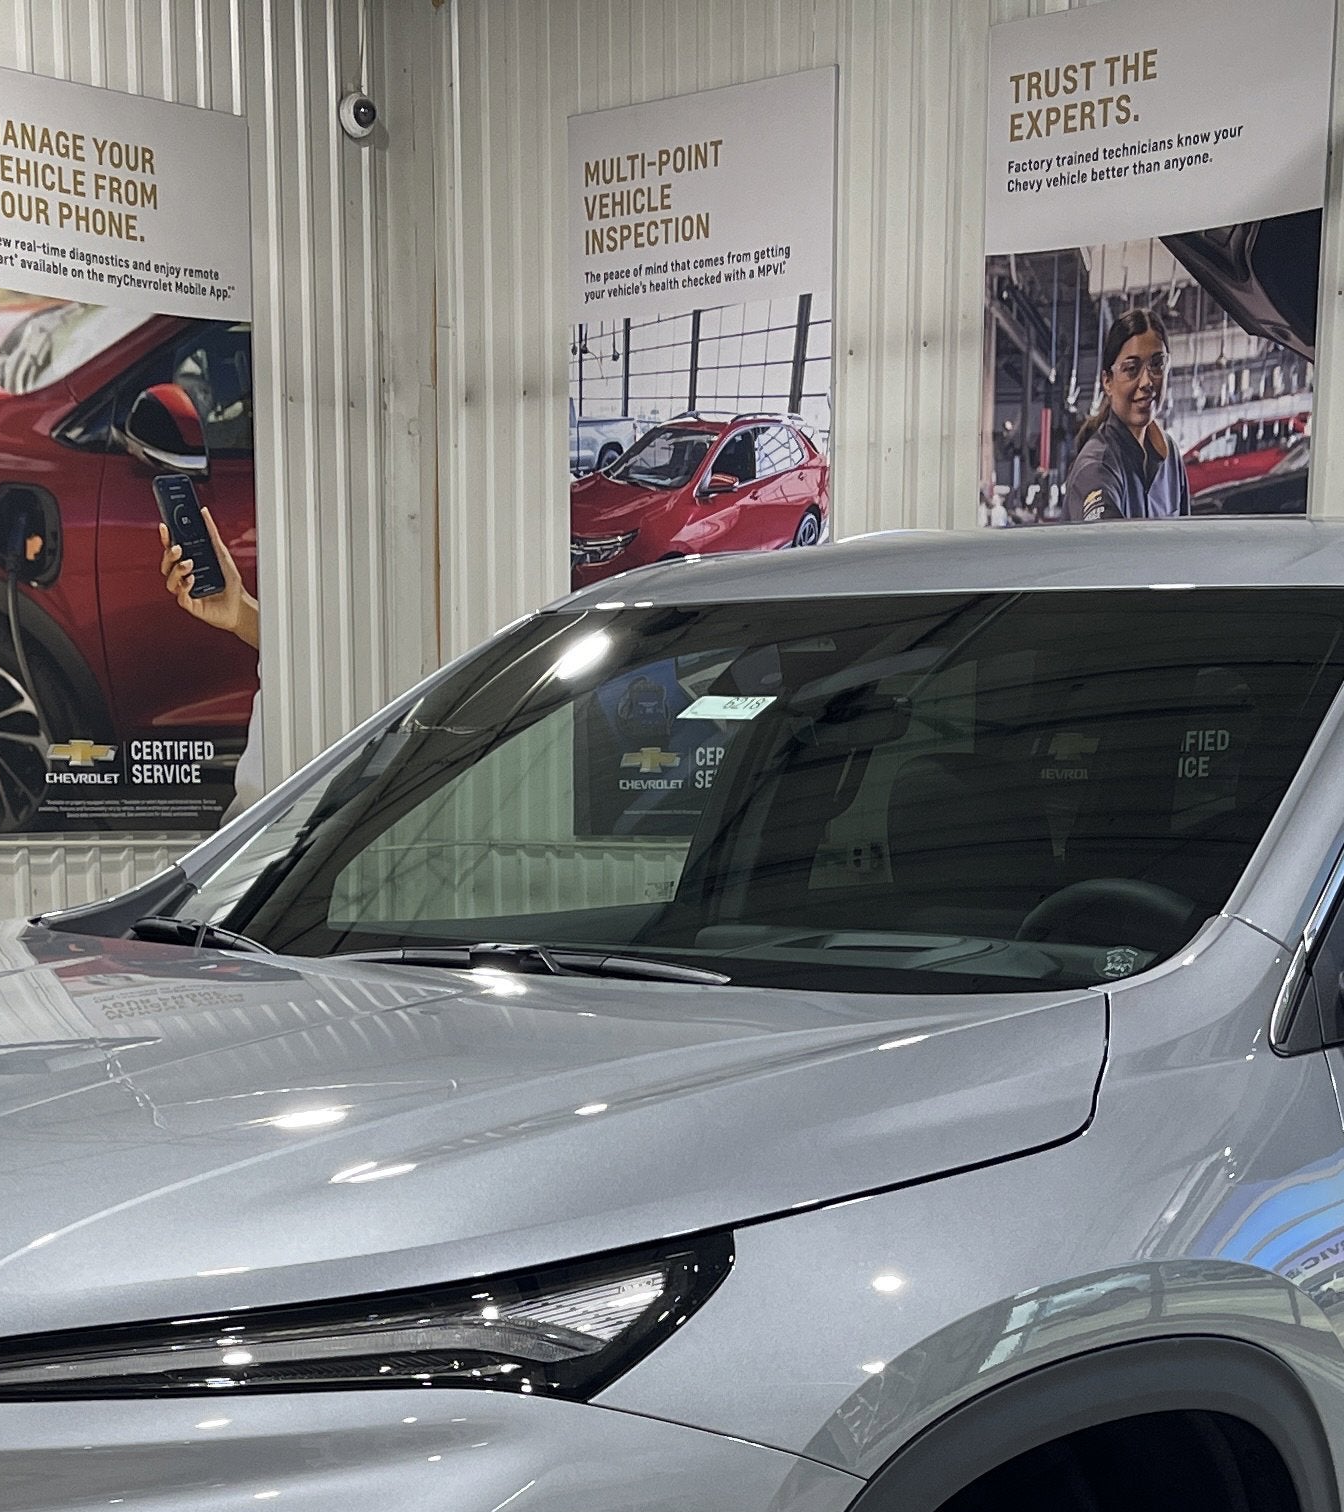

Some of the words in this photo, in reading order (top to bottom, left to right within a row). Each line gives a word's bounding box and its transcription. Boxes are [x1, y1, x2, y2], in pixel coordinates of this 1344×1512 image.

[1009, 60, 1096, 104] TRUST
[1104, 48, 1159, 88] THE
[1009, 93, 1140, 143] EXPERTS.
[92, 136, 155, 176] YOUR
[584, 139, 724, 188] MULTI-POINT
[1008, 157, 1053, 175] Factory
[1056, 147, 1099, 168] trained
[1102, 137, 1174, 162] technicians
[1176, 131, 1211, 150] know
[1214, 125, 1244, 145] your
[94, 173, 158, 211] FROM
[1007, 176, 1043, 194] Chevy
[1045, 169, 1088, 189] vehicle
[1090, 163, 1130, 183] better
[1132, 159, 1161, 178] than
[1163, 152, 1214, 172] anyone.
[58, 202, 146, 242] PHONE.
[584, 183, 673, 222] VEHICLE
[585, 212, 710, 256] INSPECTION
[14, 238, 67, 259] real-time
[69, 247, 130, 270] diagnostics
[132, 258, 152, 273] and
[154, 262, 182, 279] enjoy
[183, 267, 220, 282] remote
[20, 257, 69, 278] available
[71, 267, 85, 280] on
[87, 269, 105, 284] the
[107, 273, 173, 295] myChevrolet
[175, 281, 207, 297] Mobile
[584, 271, 601, 285] The
[603, 268, 631, 286] peace
[633, 264, 643, 277] of
[645, 262, 668, 277] mind
[671, 259, 691, 274] that
[693, 256, 725, 271] comes
[727, 250, 751, 265] from
[754, 245, 791, 265] getting
[584, 288, 605, 304] your
[607, 283, 647, 298] vehicle's
[649, 278, 679, 294] health
[681, 272, 722, 290] checked
[724, 269, 746, 284] with
[749, 269, 756, 280] a
[131, 740, 215, 761] CERTIFIED
[45, 772, 121, 785] CHEVROLET
[131, 764, 202, 784] SERVICE
[618, 779, 684, 790] CHEVROLET
[694, 770, 718, 788] SE
